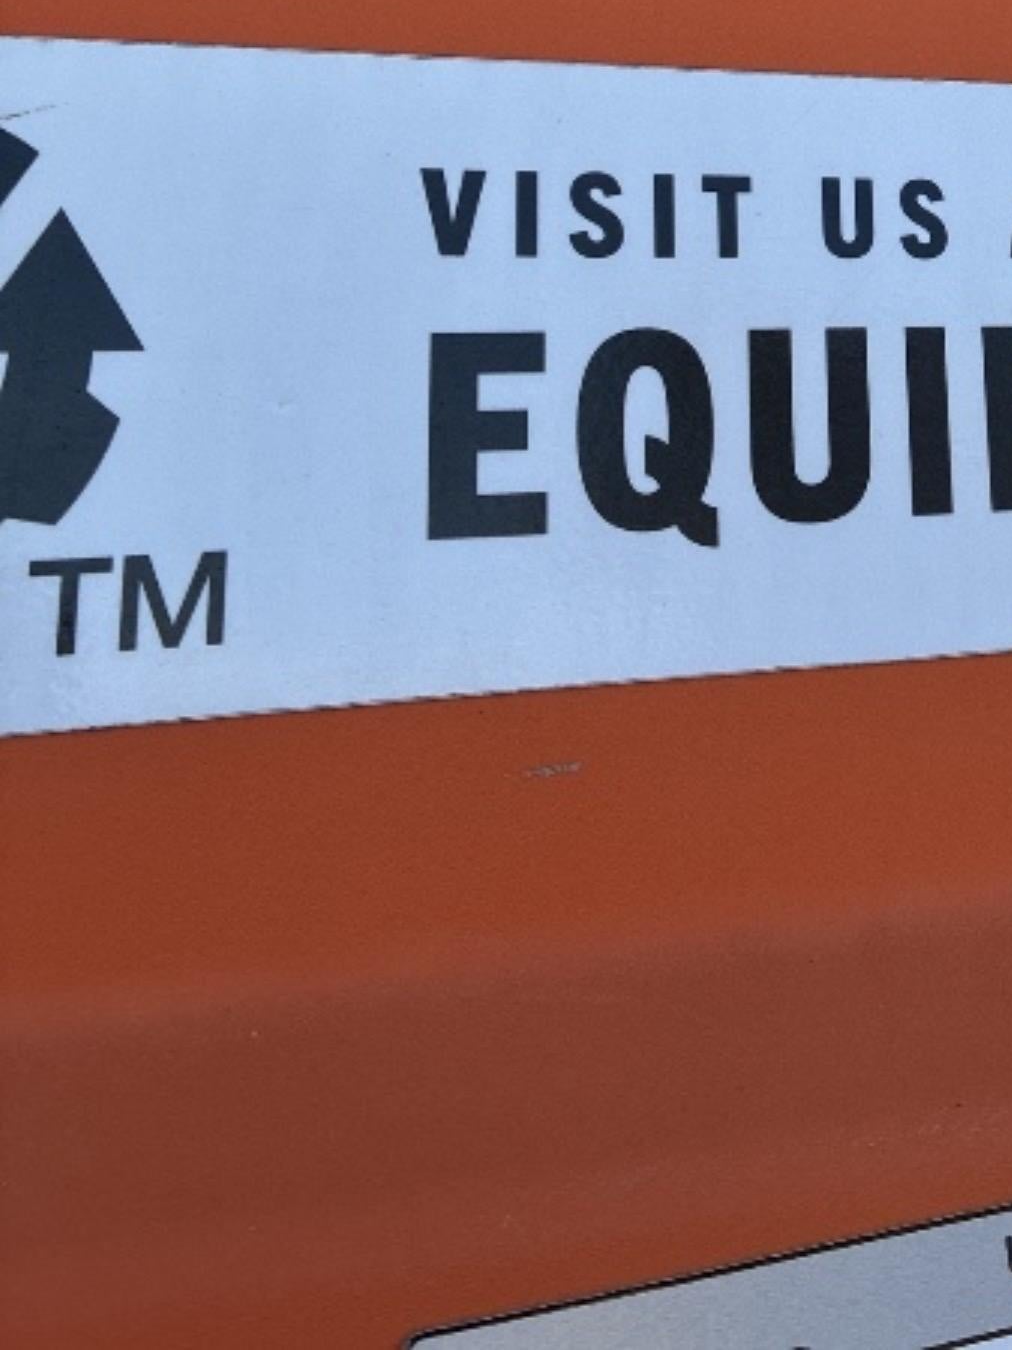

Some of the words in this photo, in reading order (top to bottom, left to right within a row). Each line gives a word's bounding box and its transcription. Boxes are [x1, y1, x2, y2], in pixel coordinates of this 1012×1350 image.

[420, 167, 752, 259] VISIT
[820, 176, 949, 261] US
[29, 549, 228, 657] TM
